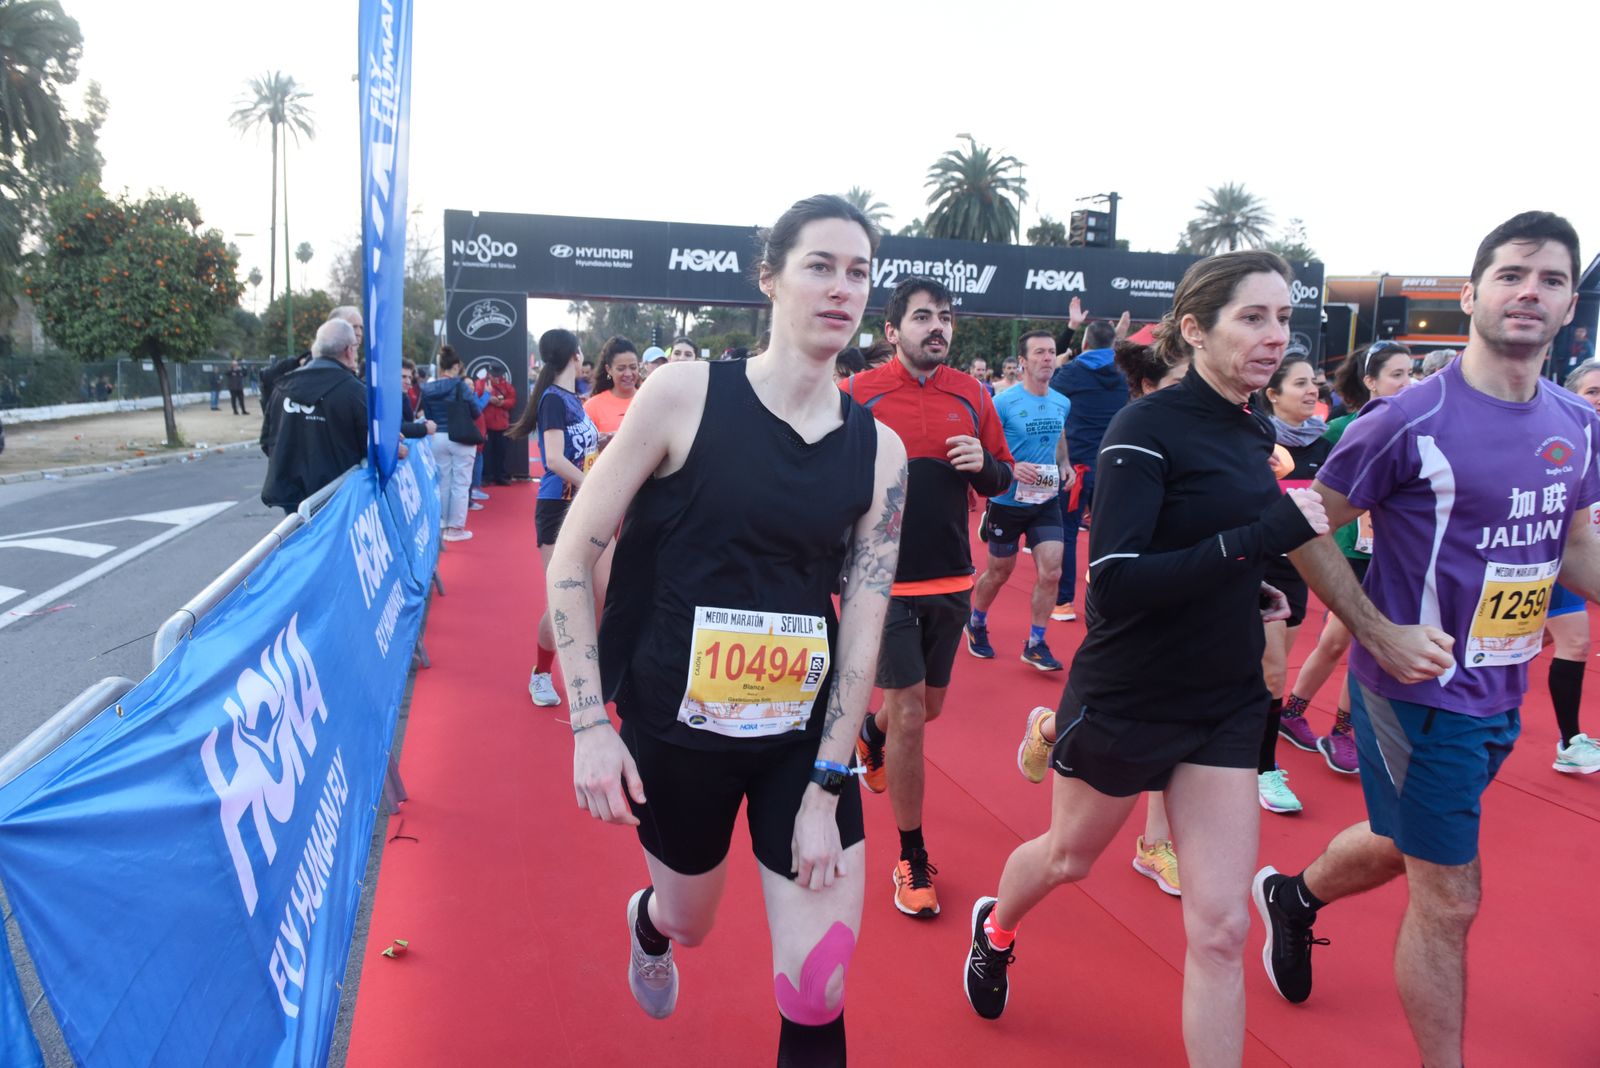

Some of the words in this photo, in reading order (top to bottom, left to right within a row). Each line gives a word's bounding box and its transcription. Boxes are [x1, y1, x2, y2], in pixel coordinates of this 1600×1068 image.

[370, 52, 382, 120] FLY
[575, 246, 634, 260] HYUNDAI
[668, 247, 741, 273] HOKA
[892, 258, 978, 279] maratón
[1025, 269, 1087, 292] HOKA
[1130, 279, 1175, 291] HYUNDAI
[1507, 482, 1567, 520] 加联
[1476, 519, 1563, 550] JALIAN
[350, 501, 394, 610] HOKA
[1489, 584, 1553, 620] 1259
[705, 610, 729, 624] MEDIO
[730, 612, 764, 628] MARATÓN
[780, 615, 814, 634] SEVILLA
[705, 641, 809, 684] 10494
[742, 683, 765, 691] Blanca
[201, 611, 328, 918] HOKA
[269, 902, 307, 1018] FLY
[290, 785, 343, 942] HUMAN
[326, 744, 349, 806] FLY
